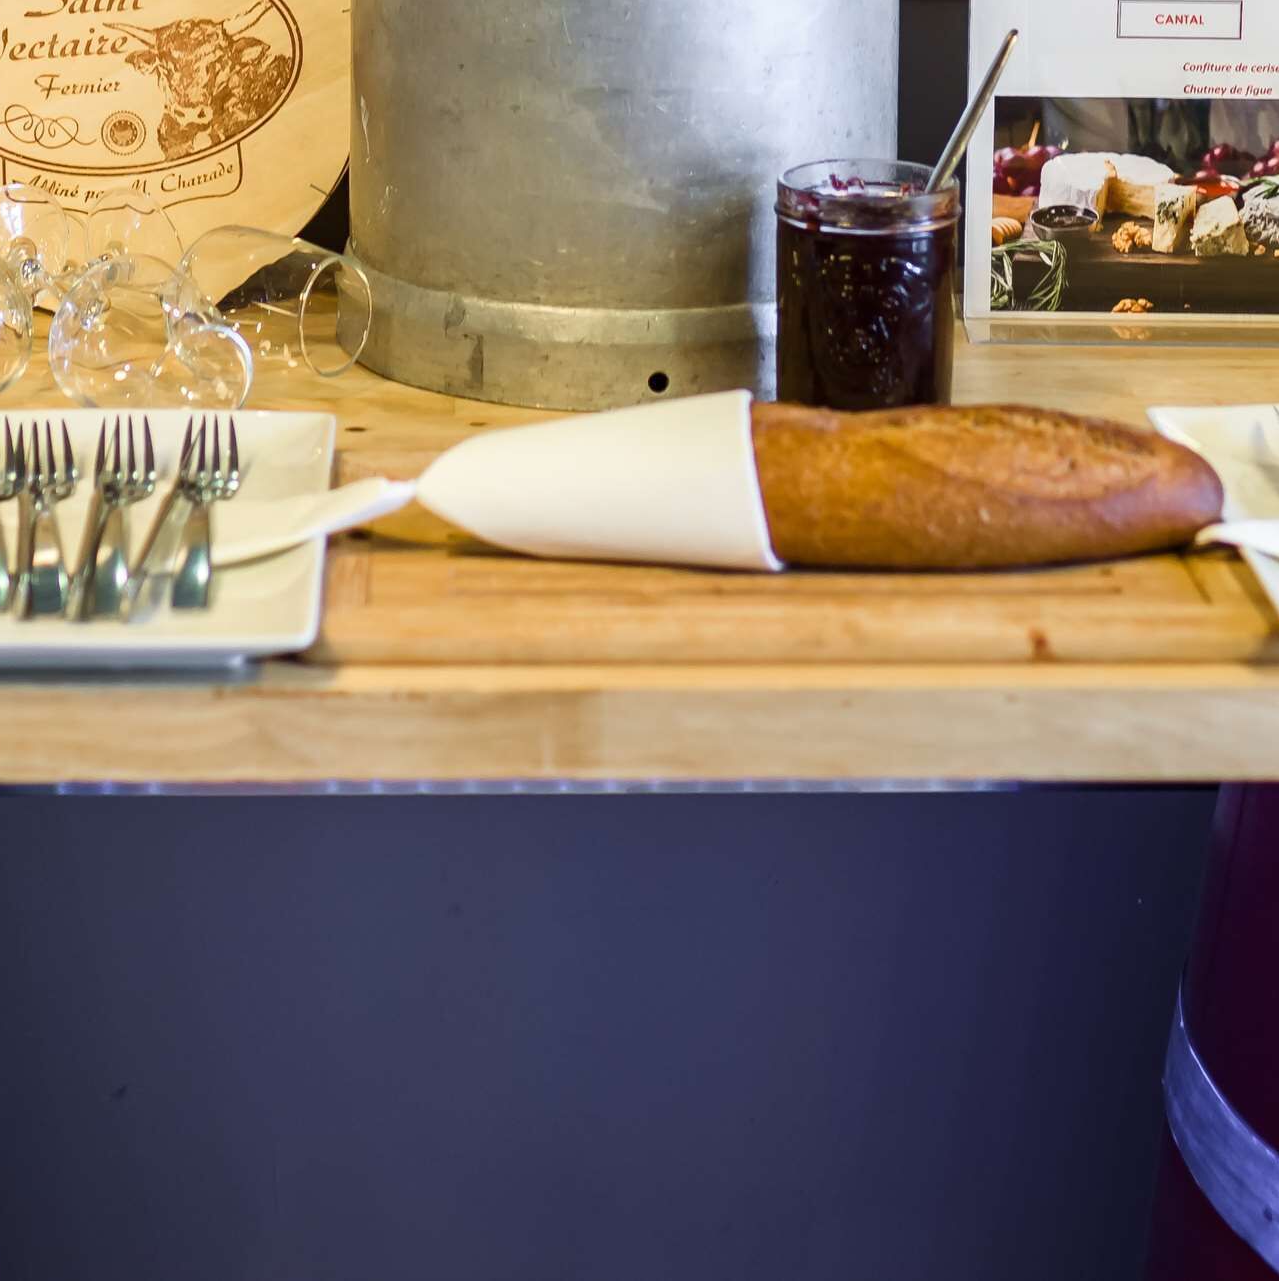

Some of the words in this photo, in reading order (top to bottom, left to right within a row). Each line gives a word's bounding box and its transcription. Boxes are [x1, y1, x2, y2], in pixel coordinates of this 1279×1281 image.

[1154, 13, 1205, 26] CANTAL
[1182, 61, 1232, 74] Confiture
[1235, 62, 1248, 73] de
[33, 73, 122, 101] Fermier
[1183, 84, 1227, 96] Chutney
[1229, 85, 1243, 95] de
[1245, 85, 1273, 96] figue
[160, 162, 234, 193] Charrade
